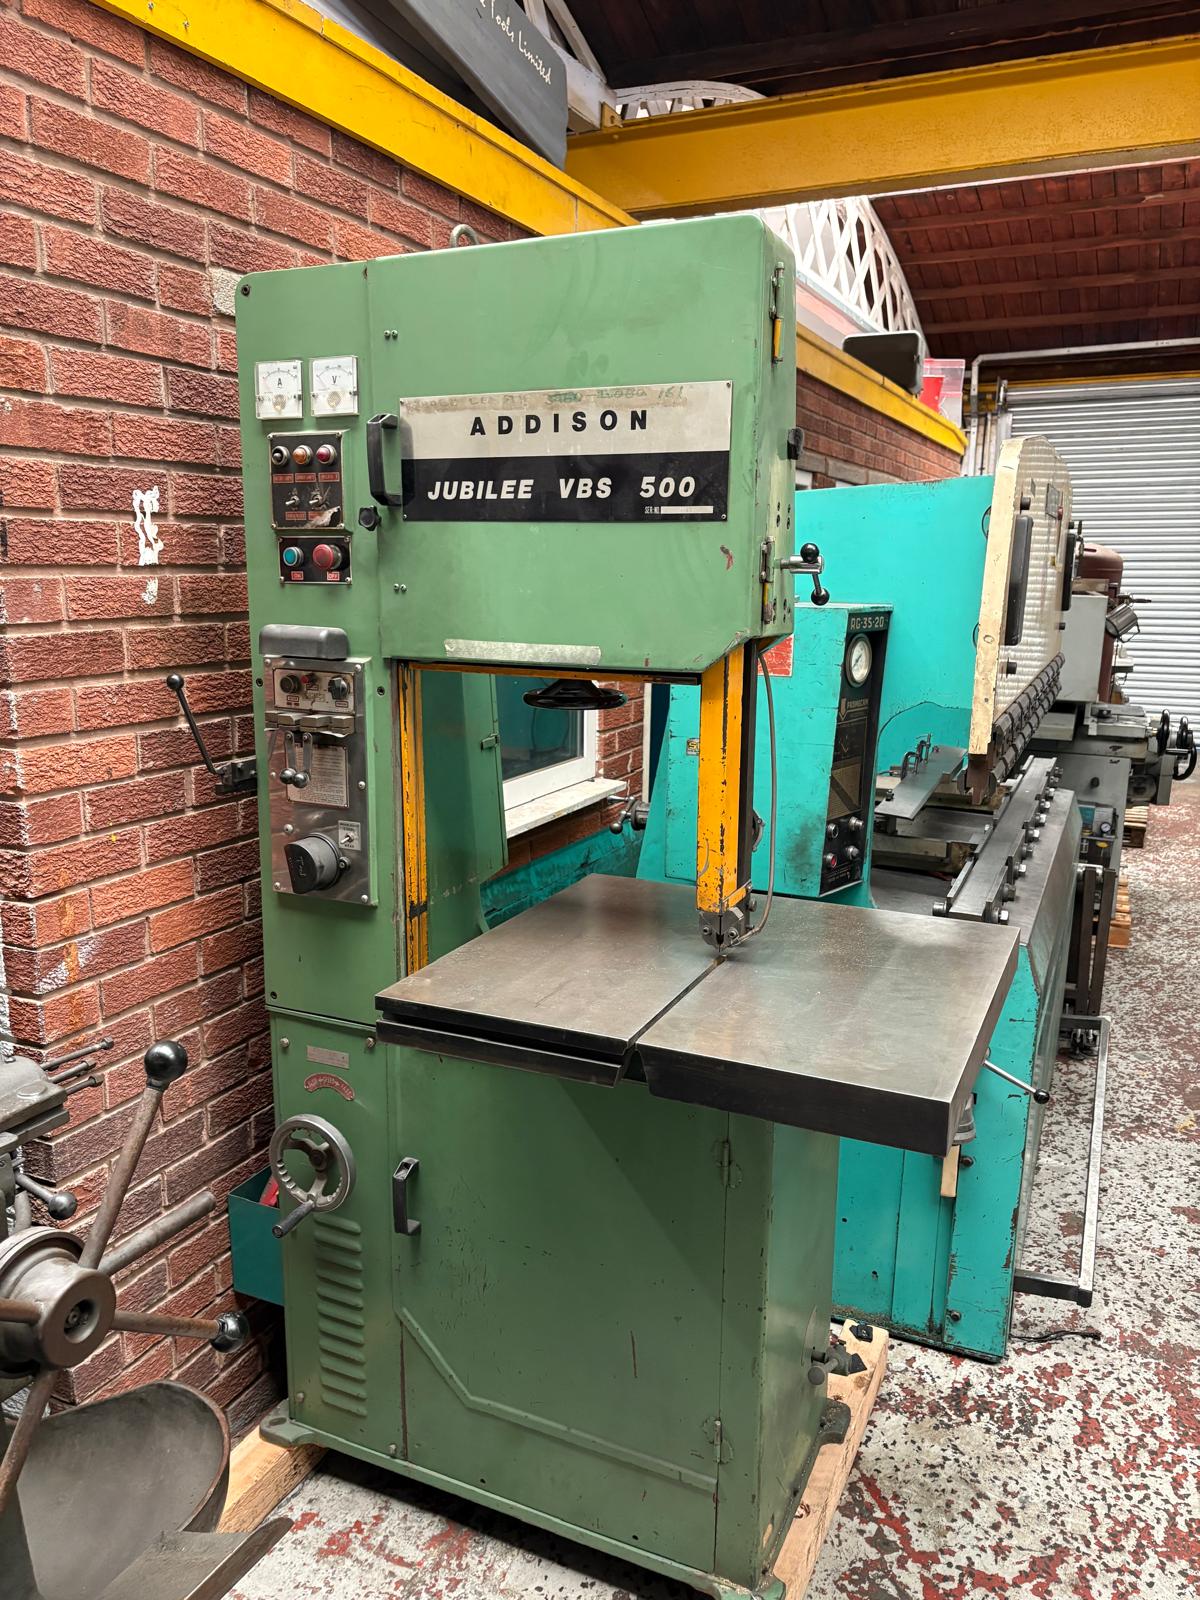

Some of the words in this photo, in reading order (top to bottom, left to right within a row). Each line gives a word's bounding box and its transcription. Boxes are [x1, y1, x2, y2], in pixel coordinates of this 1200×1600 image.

[518, 30, 552, 85] Limited
[470, 409, 648, 436] ADDISON
[427, 479, 535, 501] JUBILEE
[558, 477, 613, 499] VBS
[639, 476, 697, 498] 500
